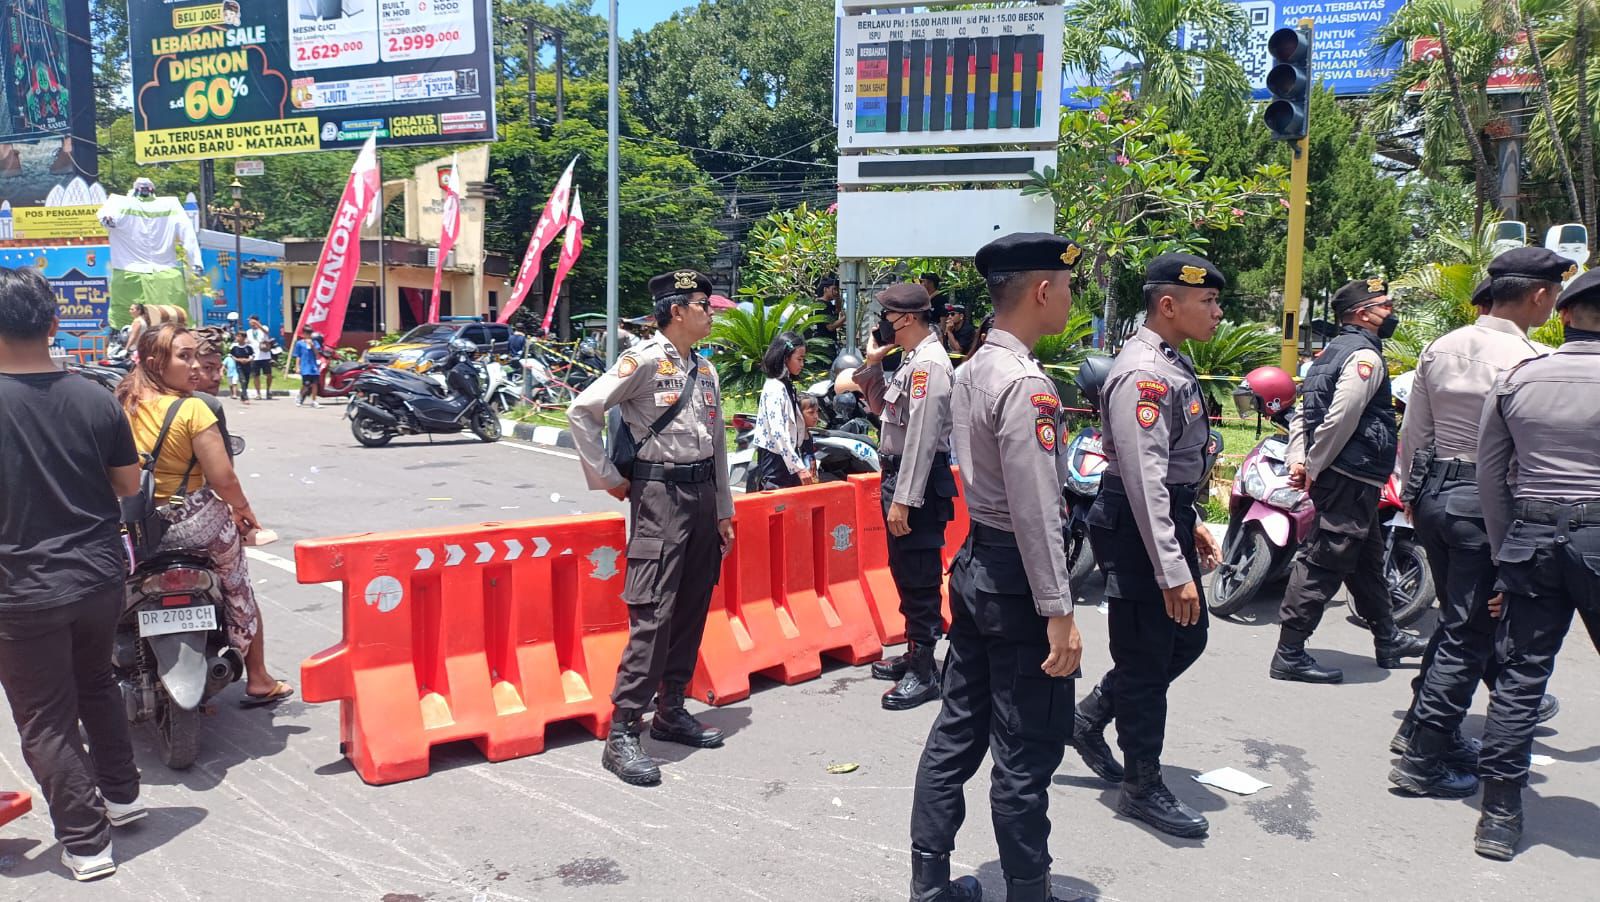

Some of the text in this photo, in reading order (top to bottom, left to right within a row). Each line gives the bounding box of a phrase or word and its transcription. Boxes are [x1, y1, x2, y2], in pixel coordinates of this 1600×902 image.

[382, 2, 405, 10] BUILT
[434, 3, 459, 11] HOOD
[1282, 0, 1385, 15] KUOTA TERBATAS
[178, 9, 221, 24] BELI JOG!
[393, 9, 410, 17] HOB
[858, 19, 892, 30] BERLAKU
[893, 19, 904, 28] Pkl
[911, 17, 930, 28] 15.00
[932, 16, 950, 26] HARI
[951, 16, 962, 25] INI
[979, 15, 991, 23] Pkl
[997, 13, 1016, 22] 15.00
[1018, 12, 1045, 22] BESOK
[1284, 16, 1299, 26] 40
[293, 25, 316, 34] MESIN
[868, 32, 881, 40] ISPU
[890, 30, 903, 39] PM10
[911, 29, 925, 38] PM2.5
[1027, 24, 1035, 32] HC
[1314, 29, 1356, 40] UNTUK
[152, 25, 266, 55] LEBARAN SALE
[845, 48, 855, 57] 500
[169, 50, 248, 82] DISKON
[844, 67, 854, 76] 300
[432, 82, 455, 92] JUTA
[844, 84, 854, 93] 200
[859, 84, 872, 92] TIDAK
[169, 96, 184, 109] s.d
[844, 102, 853, 111] 100
[393, 115, 435, 127] GRATIS
[847, 120, 853, 128] 50
[149, 122, 307, 145] JL. TERUSAN BUNG HATTA
[394, 125, 437, 138] ONGKIR
[849, 136, 853, 144] 0
[144, 143, 195, 158] KARANG
[200, 139, 234, 153] BARU
[246, 134, 315, 150] MATARAM
[25, 210, 44, 218] POS
[306, 199, 359, 325] HONDA
[59, 305, 94, 317] 2026
[656, 379, 684, 389] ARIES
[142, 608, 212, 625] DR 2703 CH
[181, 621, 214, 629] 03.29
